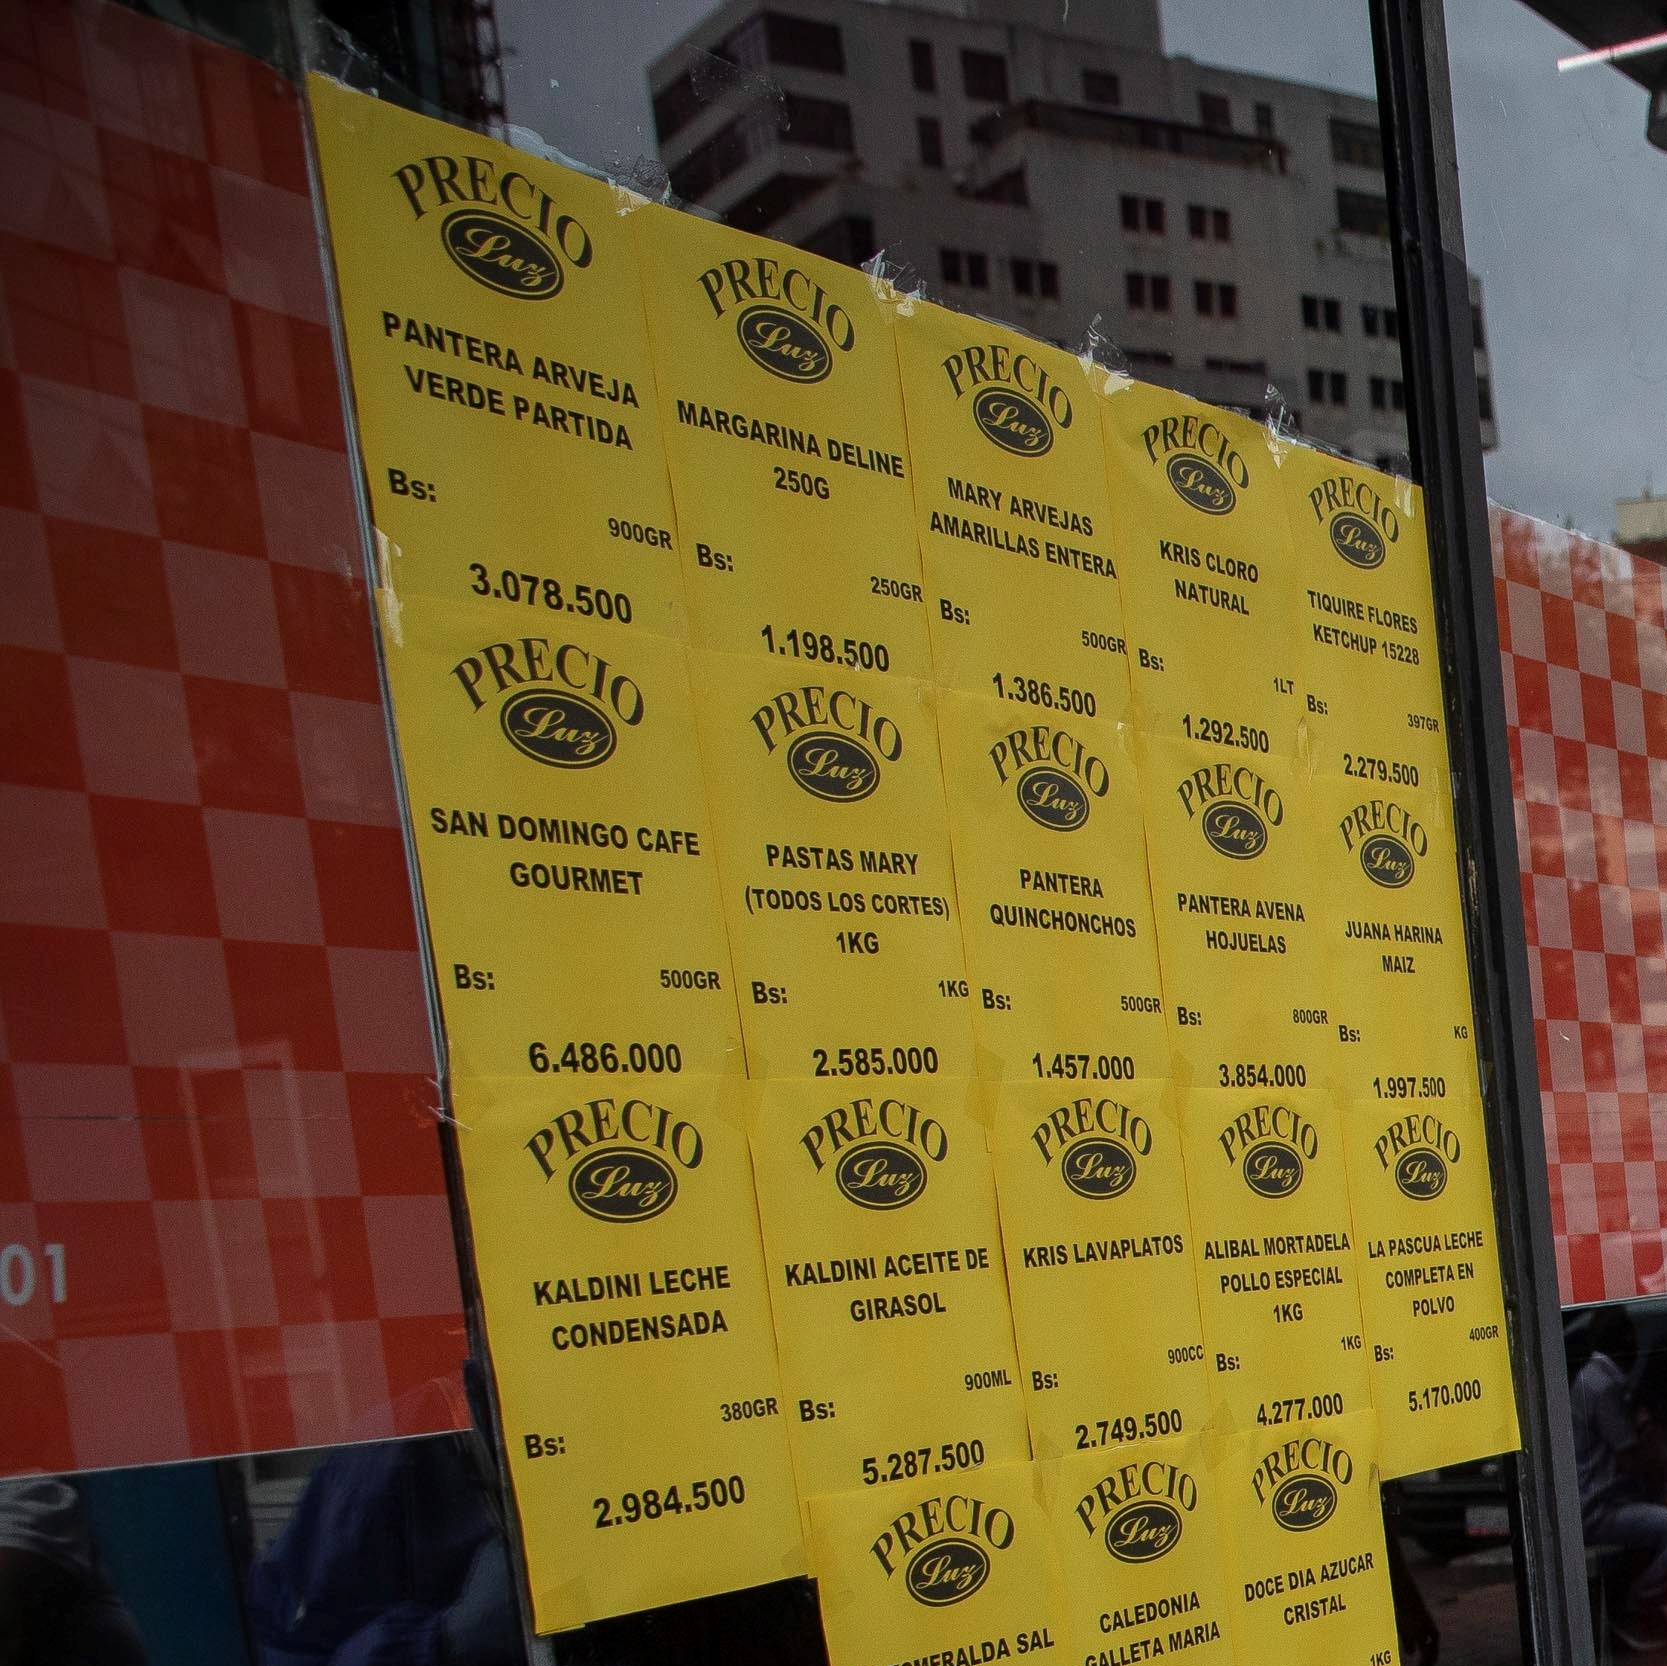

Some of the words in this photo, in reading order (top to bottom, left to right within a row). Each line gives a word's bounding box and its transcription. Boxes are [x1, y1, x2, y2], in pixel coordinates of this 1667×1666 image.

[389, 154, 594, 270] PRECIO
[695, 257, 856, 353] PRECIO
[380, 309, 525, 377] PANTERA
[531, 355, 640, 409] ARVEJA
[940, 344, 1074, 430] PRECIO
[403, 364, 506, 417] VERDE
[513, 394, 634, 451] PARTIDA
[675, 398, 823, 459] MARGARINA
[826, 437, 906, 480] DELINE
[1139, 414, 1250, 490] PRECIO
[386, 467, 437, 504] Bs:
[772, 465, 831, 501] 250G
[947, 476, 1002, 512] MARY
[1009, 494, 1093, 537] ARVEJAS
[1307, 475, 1400, 544] PRECIO
[606, 516, 674, 552] 900GR
[929, 510, 1041, 560] AMARILLAS
[1044, 540, 1118, 581] ENTERA
[695, 541, 734, 573] Bs:
[1158, 538, 1202, 569] KRIS
[1204, 551, 1260, 584] CLORO
[468, 561, 633, 625] 3.078.500
[869, 575, 924, 604] 250GR
[1173, 577, 1251, 617] NATURAL
[938, 597, 971, 626] Bs:
[1305, 588, 1366, 622] TIQUIRE
[1366, 604, 1419, 636] FLORES
[760, 623, 891, 673] 1.198.500
[1080, 629, 1128, 656] 500GR
[1137, 646, 1165, 673] Bs:
[1311, 622, 1378, 656] KETCHUP
[1380, 639, 1421, 667] 15228
[449, 637, 645, 727] PRECIO
[991, 671, 1097, 719] 1.386.500
[1272, 676, 1295, 695] 1LT
[514, 706, 607, 756] Luz
[749, 686, 903, 763] PRECIO
[1181, 713, 1271, 755] 1.292.500
[1407, 713, 1439, 733] 397GR
[988, 724, 1111, 798] PRECIO
[1342, 752, 1420, 789] 2.279.500
[1175, 762, 1285, 827] PRECIO
[429, 806, 490, 839] SAN
[496, 813, 630, 850] DOMINGO
[635, 826, 702, 857] CAFE
[1338, 798, 1429, 858] PRECIO
[764, 843, 855, 872] PASTAS
[858, 849, 919, 876] MARY
[509, 861, 643, 896] GOURMET
[1018, 867, 1105, 900] PANTERA
[744, 884, 823, 916] (TODOS
[826, 890, 867, 914] LOS
[870, 892, 951, 923] CORTES)
[988, 902, 1138, 939] QUINCHONCHOS
[1176, 892, 1253, 919] PANTERA
[1254, 899, 1307, 923] AVENA
[835, 930, 881, 955] 1KG
[1204, 928, 1288, 955] HOJUELAS
[1343, 920, 1392, 942] JUANA
[1392, 923, 1445, 946] HARINA
[452, 962, 496, 991] Bs:
[659, 968, 722, 991] 500GR
[1381, 953, 1417, 975] MAIZ
[750, 980, 789, 1005] Bs:
[937, 979, 971, 999] 1KG
[980, 987, 1013, 1012] Bs:
[1119, 994, 1163, 1015] 500GR
[1175, 1005, 1203, 1027] Bs:
[1291, 1007, 1330, 1026] 800GR
[1453, 1024, 1468, 1040] KG
[527, 1040, 683, 1075] 6.486.000
[811, 1046, 940, 1078] 2.585.000
[1031, 1051, 1136, 1081] 1.457.000
[1217, 1062, 1308, 1089] 3.854.000
[1372, 1075, 1447, 1100] 1.997.500
[522, 1097, 704, 1183] PRECIO
[797, 1097, 949, 1175] PRECIO
[1030, 1097, 1153, 1167] PRECIO
[1217, 1104, 1319, 1167] PRECIO
[1373, 1113, 1462, 1171] PRECIO
[1021, 1243, 1069, 1269] KRIS
[1072, 1233, 1185, 1265] LAVAPLATOS
[1203, 1237, 1261, 1261] ALIBAL
[1262, 1231, 1352, 1257] MORTADELA
[1367, 1239, 1386, 1259] LA
[1388, 1235, 1442, 1257] PASCUA
[1443, 1229, 1485, 1252] LECHE
[783, 1256, 878, 1288] KALDINI
[883, 1249, 962, 1279] ACEITE
[963, 1246, 991, 1271] DE
[1219, 1270, 1272, 1295] POLLO
[1273, 1265, 1344, 1290] ESPECIAL
[1384, 1263, 1456, 1290] COMPLETA
[1456, 1261, 1475, 1281] EN
[532, 1272, 642, 1307] KALDINI
[648, 1264, 732, 1296] LECHE
[849, 1291, 948, 1323] GIRASOL
[1272, 1301, 1304, 1324] 1KG
[1411, 1294, 1456, 1318] POLVO
[550, 1308, 730, 1352] CONDENSADA
[1339, 1334, 1363, 1352] 1KG
[1469, 1325, 1499, 1342] 400GR
[1166, 1343, 1205, 1365] 900CC
[1214, 1352, 1241, 1373] Bs:
[963, 1368, 1013, 1392] 900ML
[1030, 1369, 1060, 1393] Bs:
[1407, 1377, 1482, 1413] 5.170.000
[719, 1396, 780, 1424] 380GR
[797, 1398, 837, 1423] Bs:
[1255, 1391, 1345, 1427] 4.277.000
[522, 1433, 567, 1460] Bs:
[1073, 1407, 1183, 1451] 2.749.500
[861, 1438, 986, 1487] 5.287.500
[1250, 1437, 1354, 1507] PRECIO
[592, 1474, 746, 1530] 2.984.500
[1073, 1460, 1198, 1539] PRECIO
[869, 1494, 1016, 1580] PRECIO
[1243, 1573, 1286, 1603] DOCE
[1286, 1567, 1318, 1592] DIA
[1319, 1551, 1375, 1584] AZUCAR
[1099, 1591, 1201, 1635] CALEDONIA
[1282, 1592, 1348, 1627] CRISTAL
[1016, 1627, 1055, 1655] SAL
[1167, 1620, 1222, 1654] MARIA
